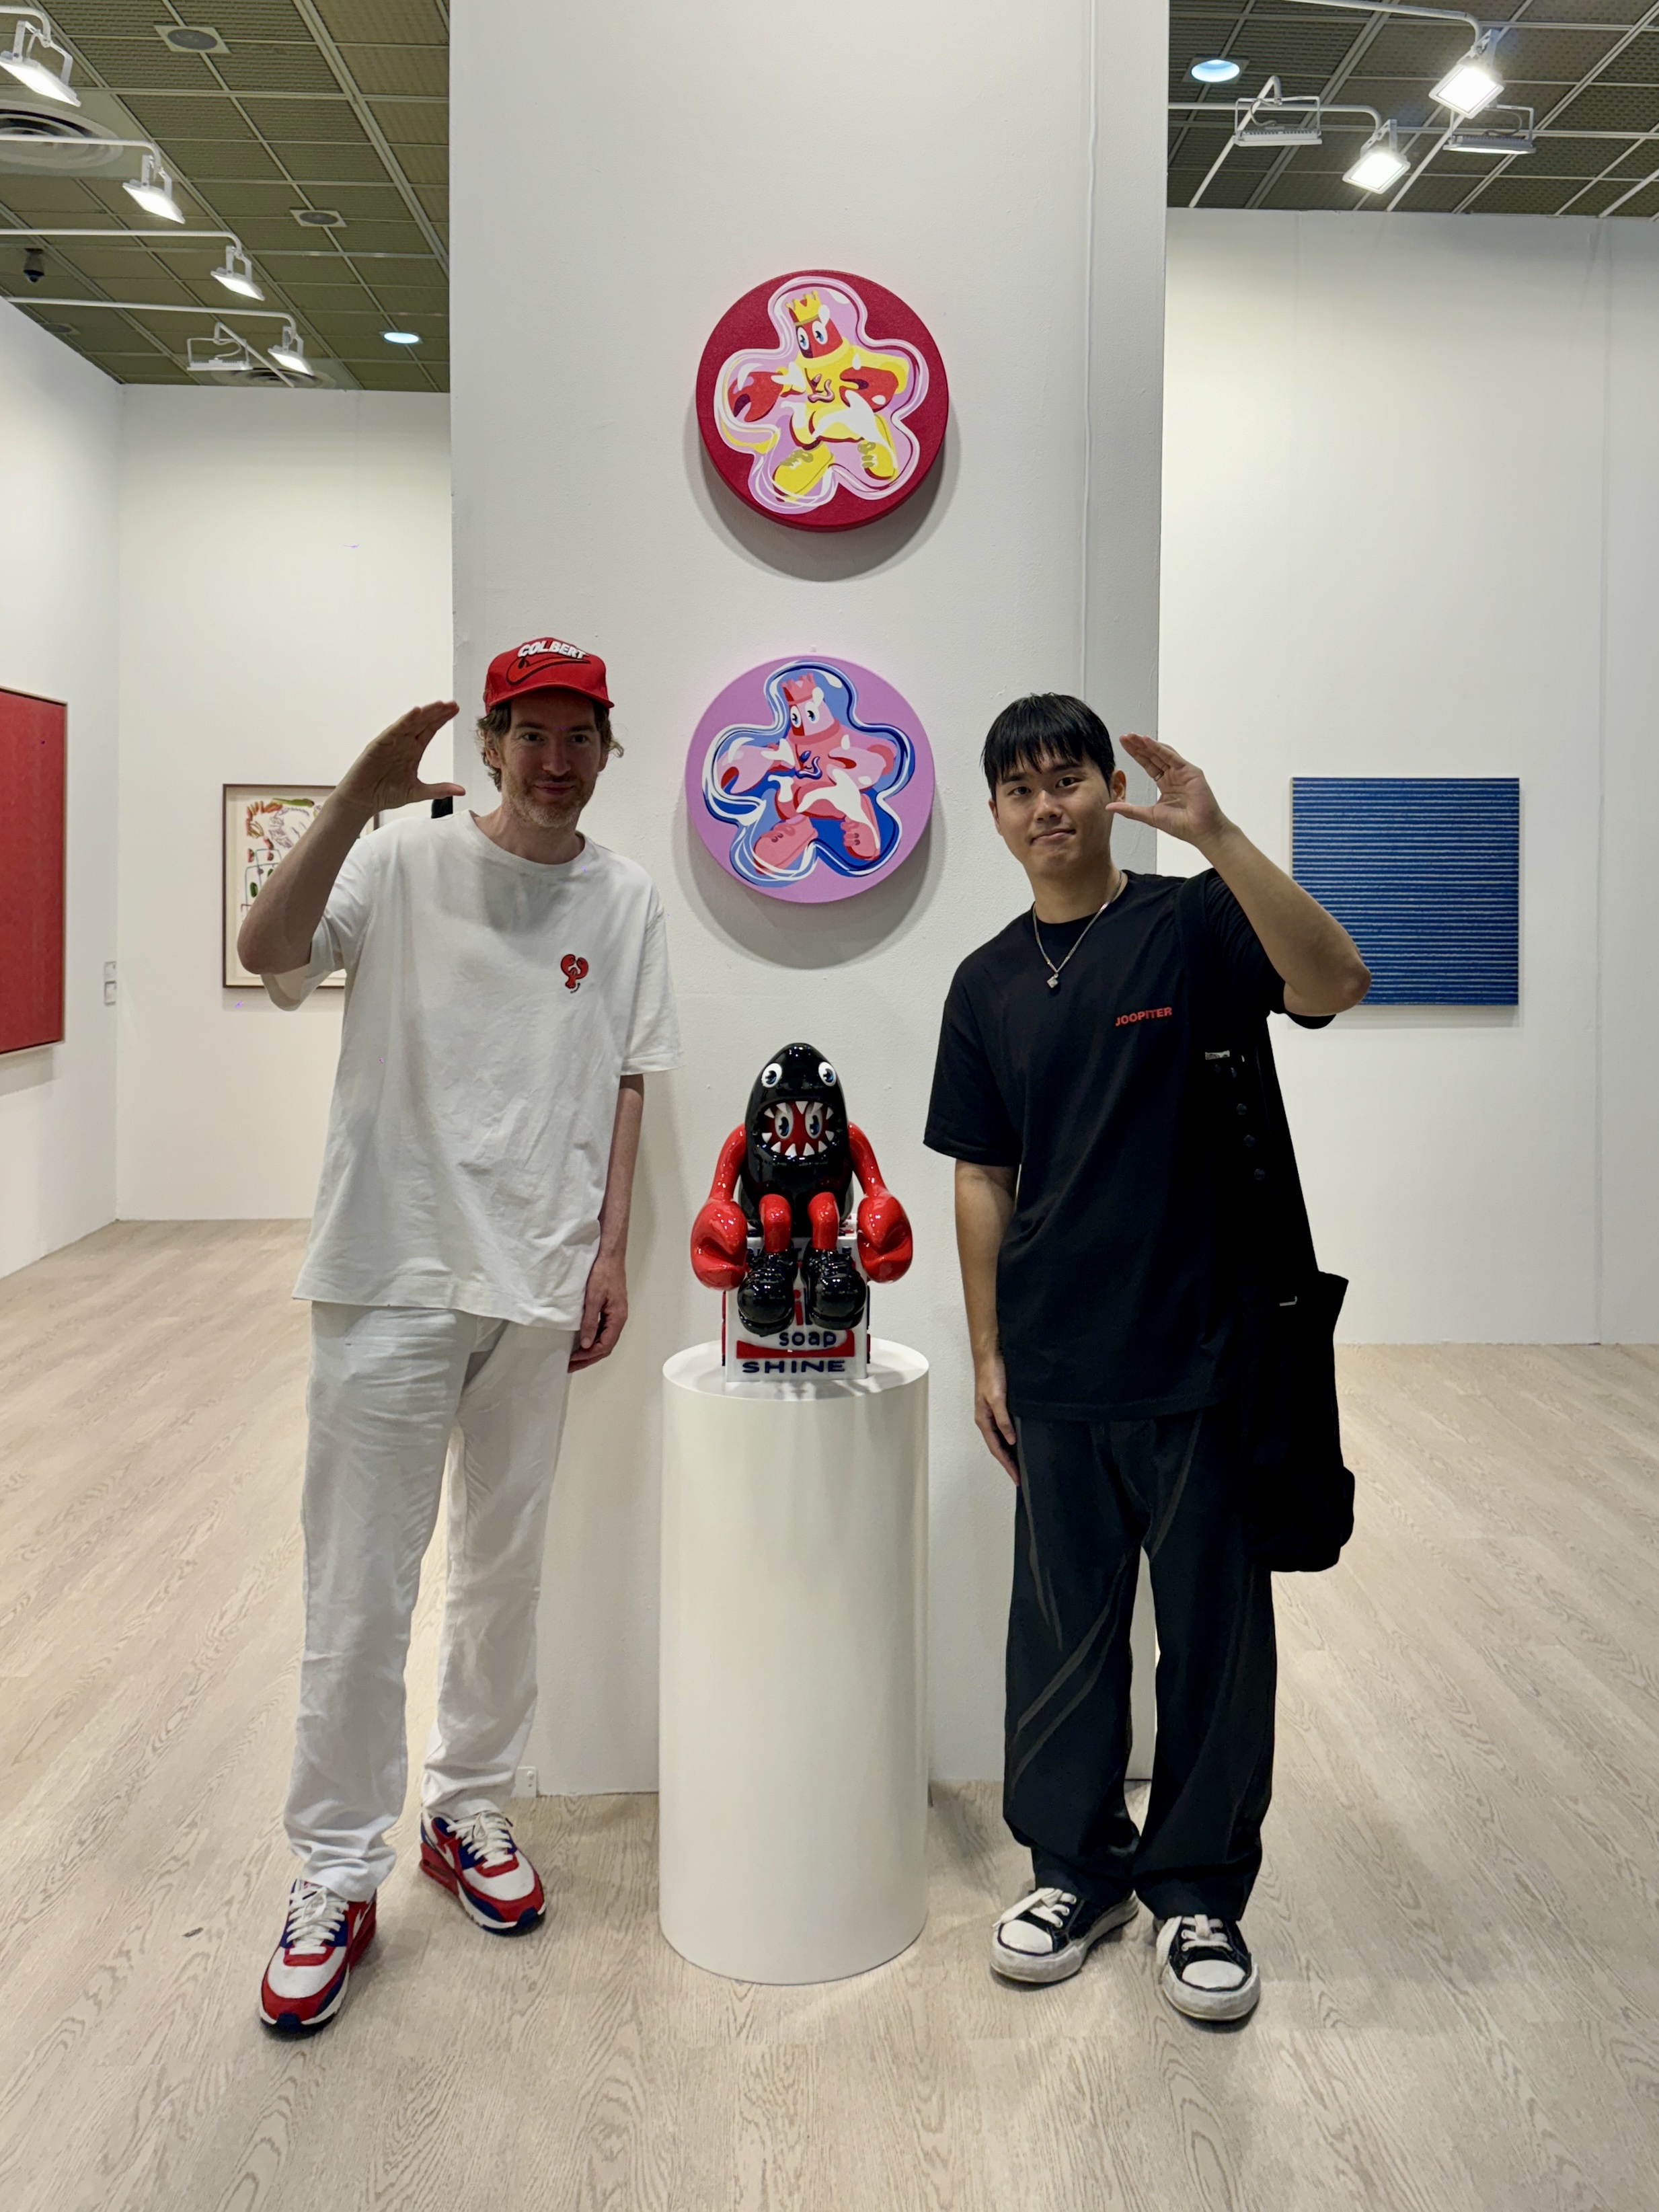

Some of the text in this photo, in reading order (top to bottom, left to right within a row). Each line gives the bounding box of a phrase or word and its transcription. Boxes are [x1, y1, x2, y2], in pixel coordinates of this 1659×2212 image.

[517, 640, 589, 659] COLBERT
[1115, 1006, 1172, 1026] JOOPITER
[779, 1331, 837, 1347] soap
[742, 1360, 845, 1373] SHINE
